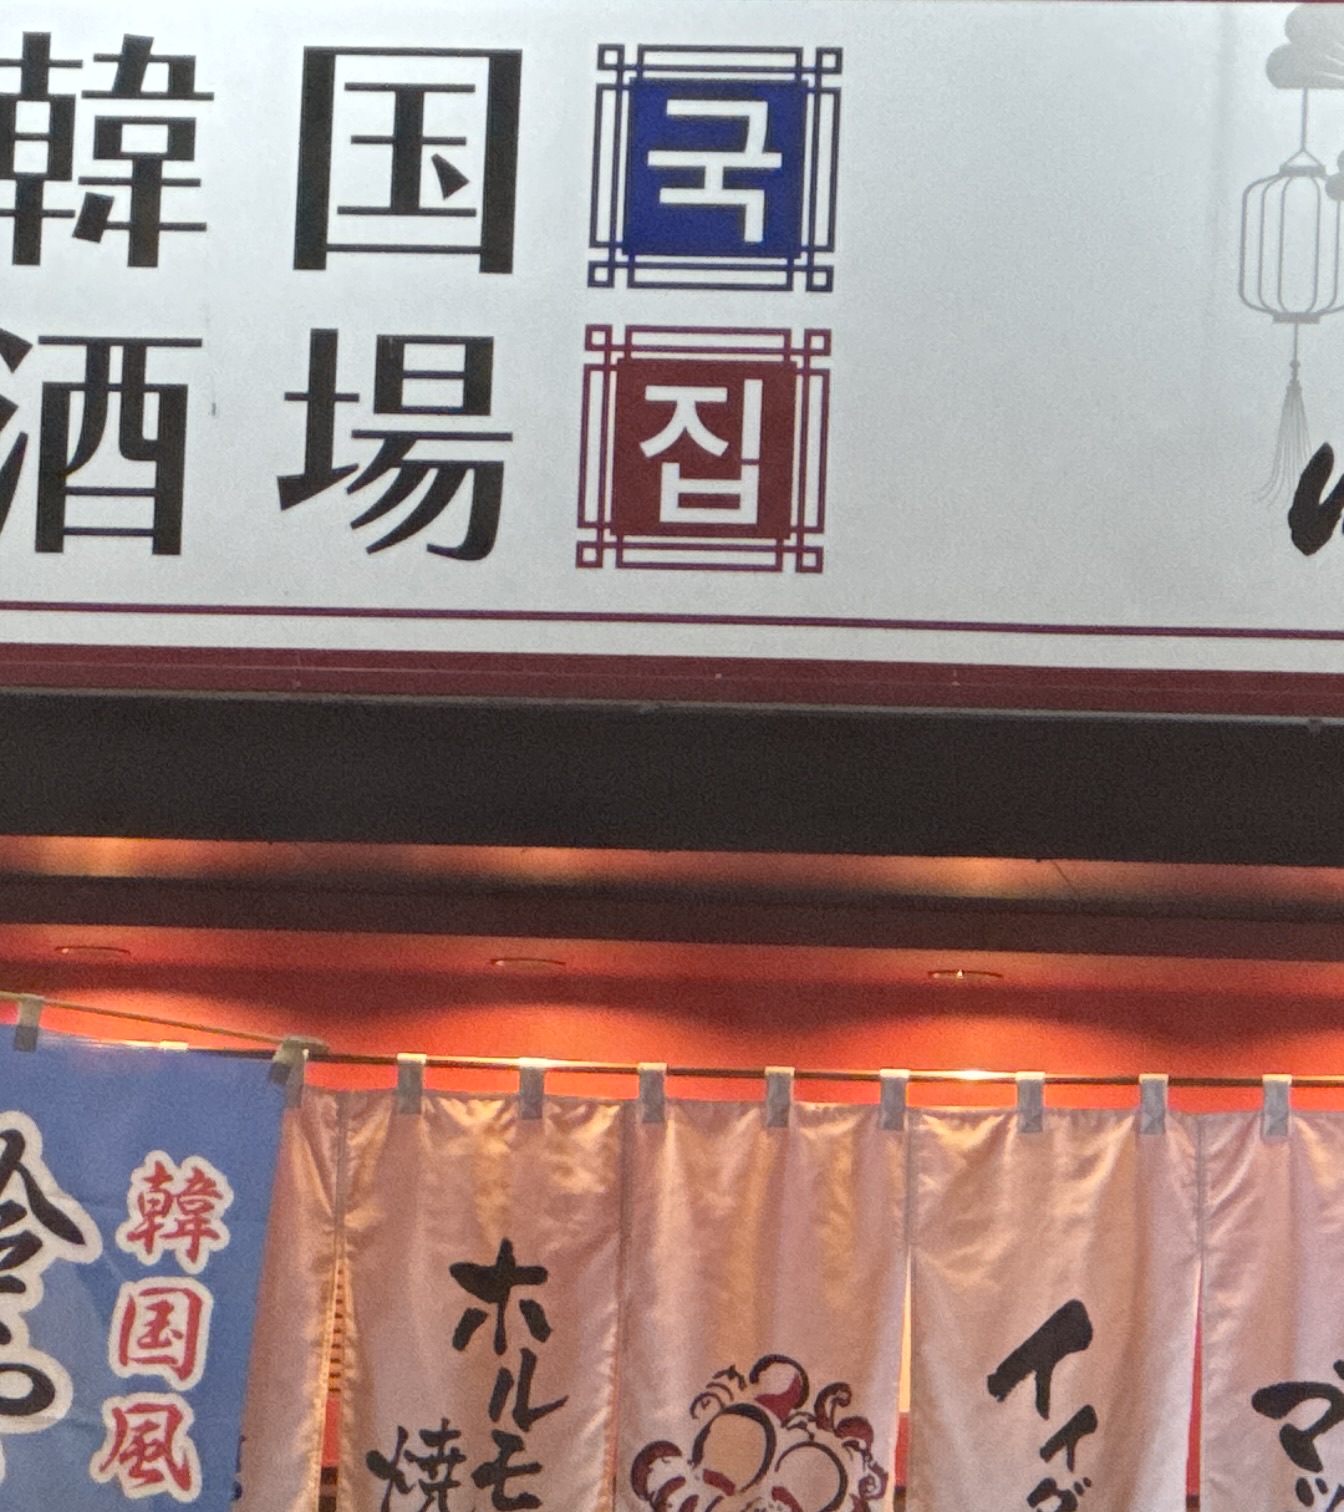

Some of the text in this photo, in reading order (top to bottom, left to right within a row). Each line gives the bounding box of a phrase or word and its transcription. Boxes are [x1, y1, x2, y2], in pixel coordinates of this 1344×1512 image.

[646, 99, 783, 244] 국
[638, 376, 764, 530] 집
[92, 1153, 233, 1501] 韓国風
